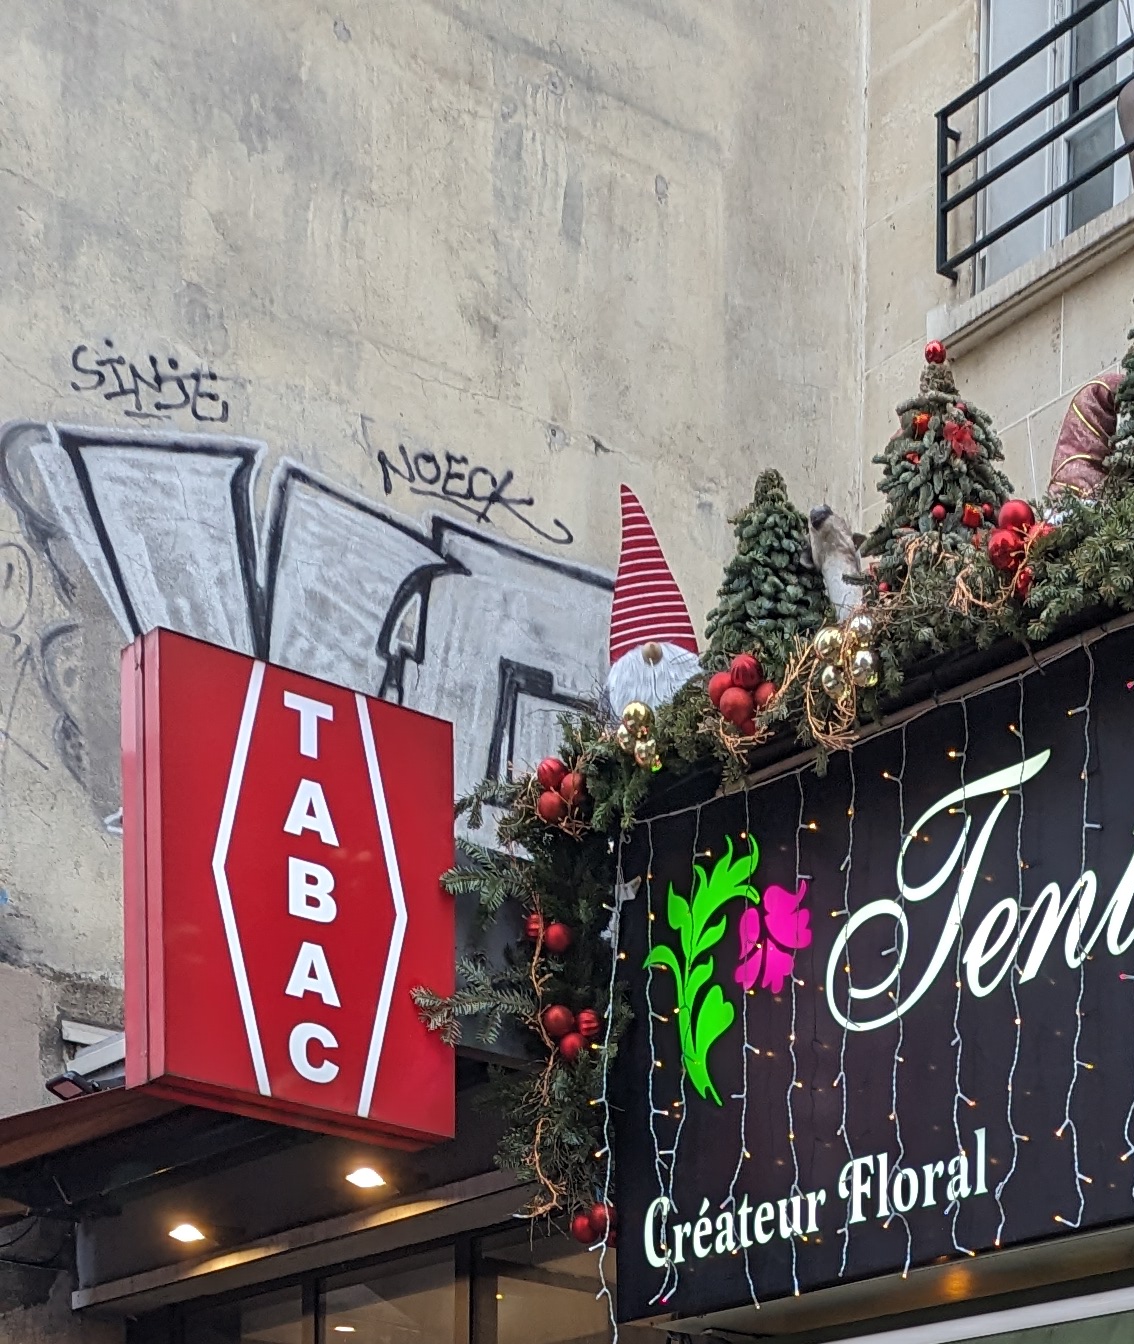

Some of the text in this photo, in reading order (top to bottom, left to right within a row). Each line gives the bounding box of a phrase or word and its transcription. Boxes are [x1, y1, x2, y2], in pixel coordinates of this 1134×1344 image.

[282, 690, 342, 1085] TABAC
[644, 1128, 990, 1268] Créateur Floral
